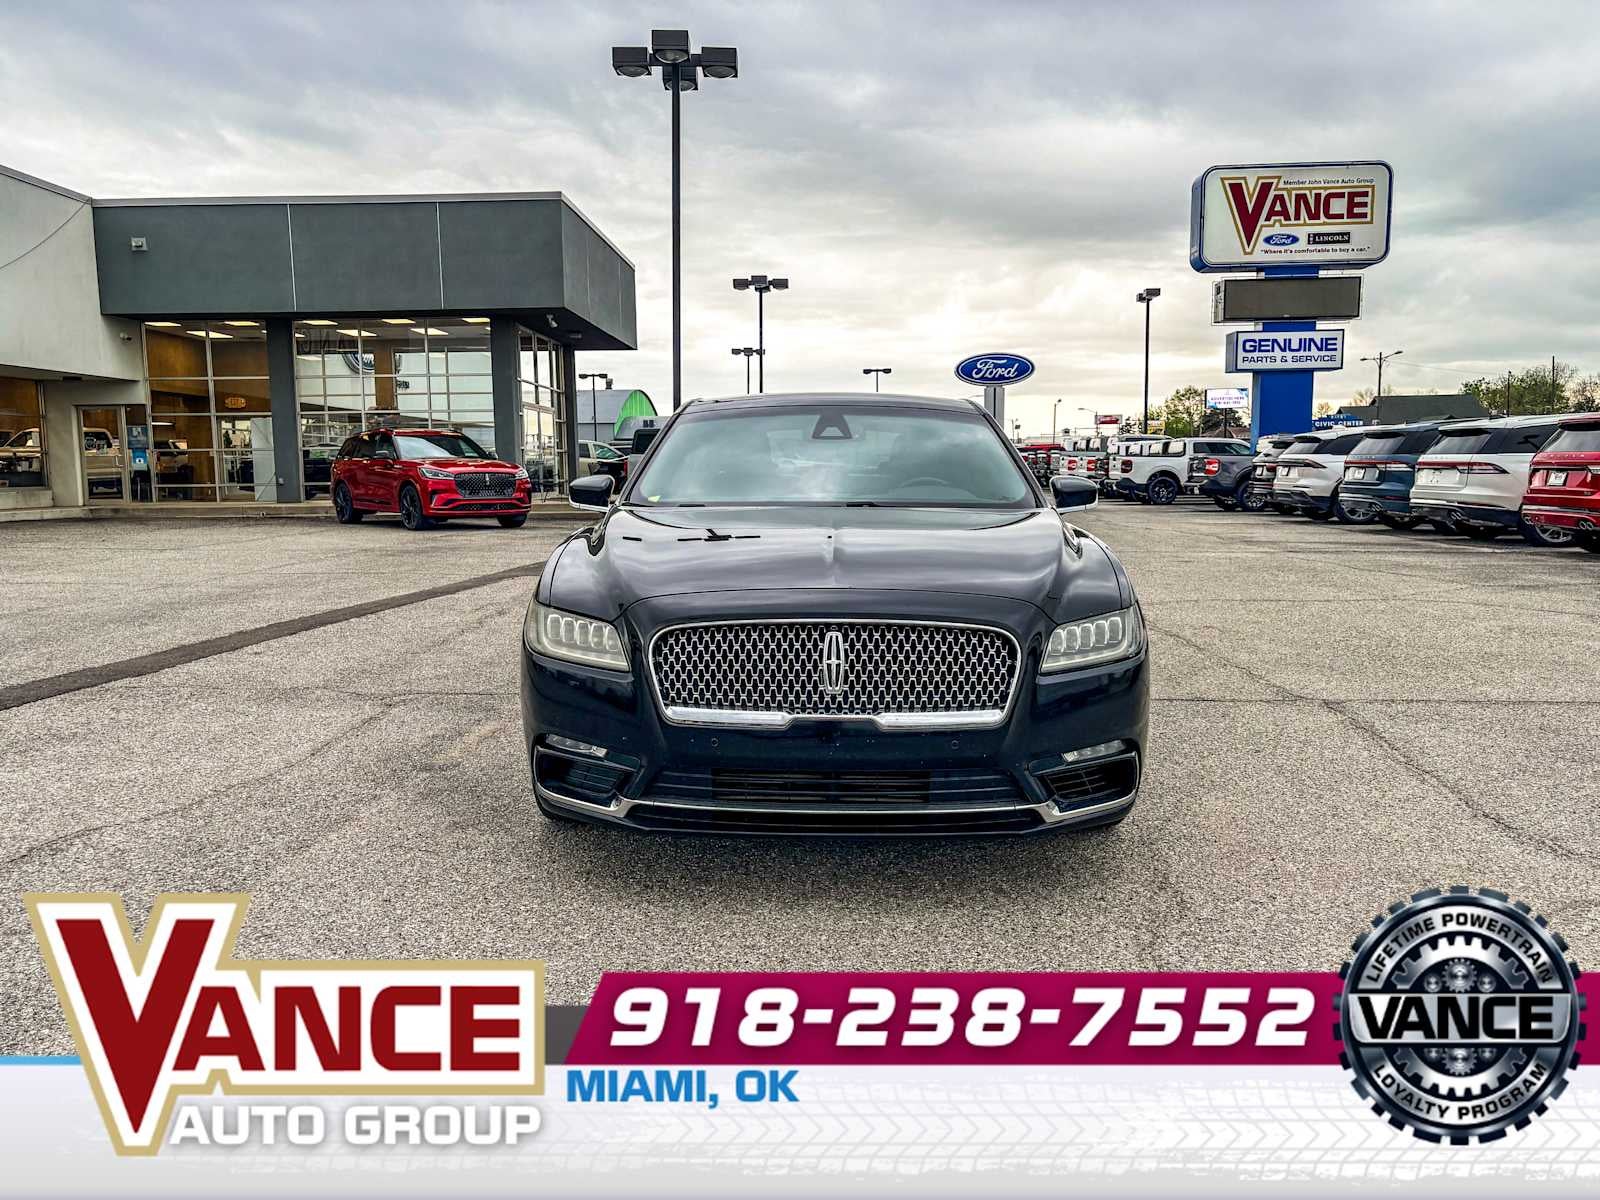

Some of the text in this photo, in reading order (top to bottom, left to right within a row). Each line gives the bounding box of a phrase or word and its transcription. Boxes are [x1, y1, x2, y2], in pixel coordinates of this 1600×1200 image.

[1228, 182, 1369, 248] VANCE
[1270, 235, 1292, 244] Ford
[1242, 337, 1338, 353] GENUINE
[1291, 354, 1336, 362] SERVICE
[972, 359, 1019, 378] Ford
